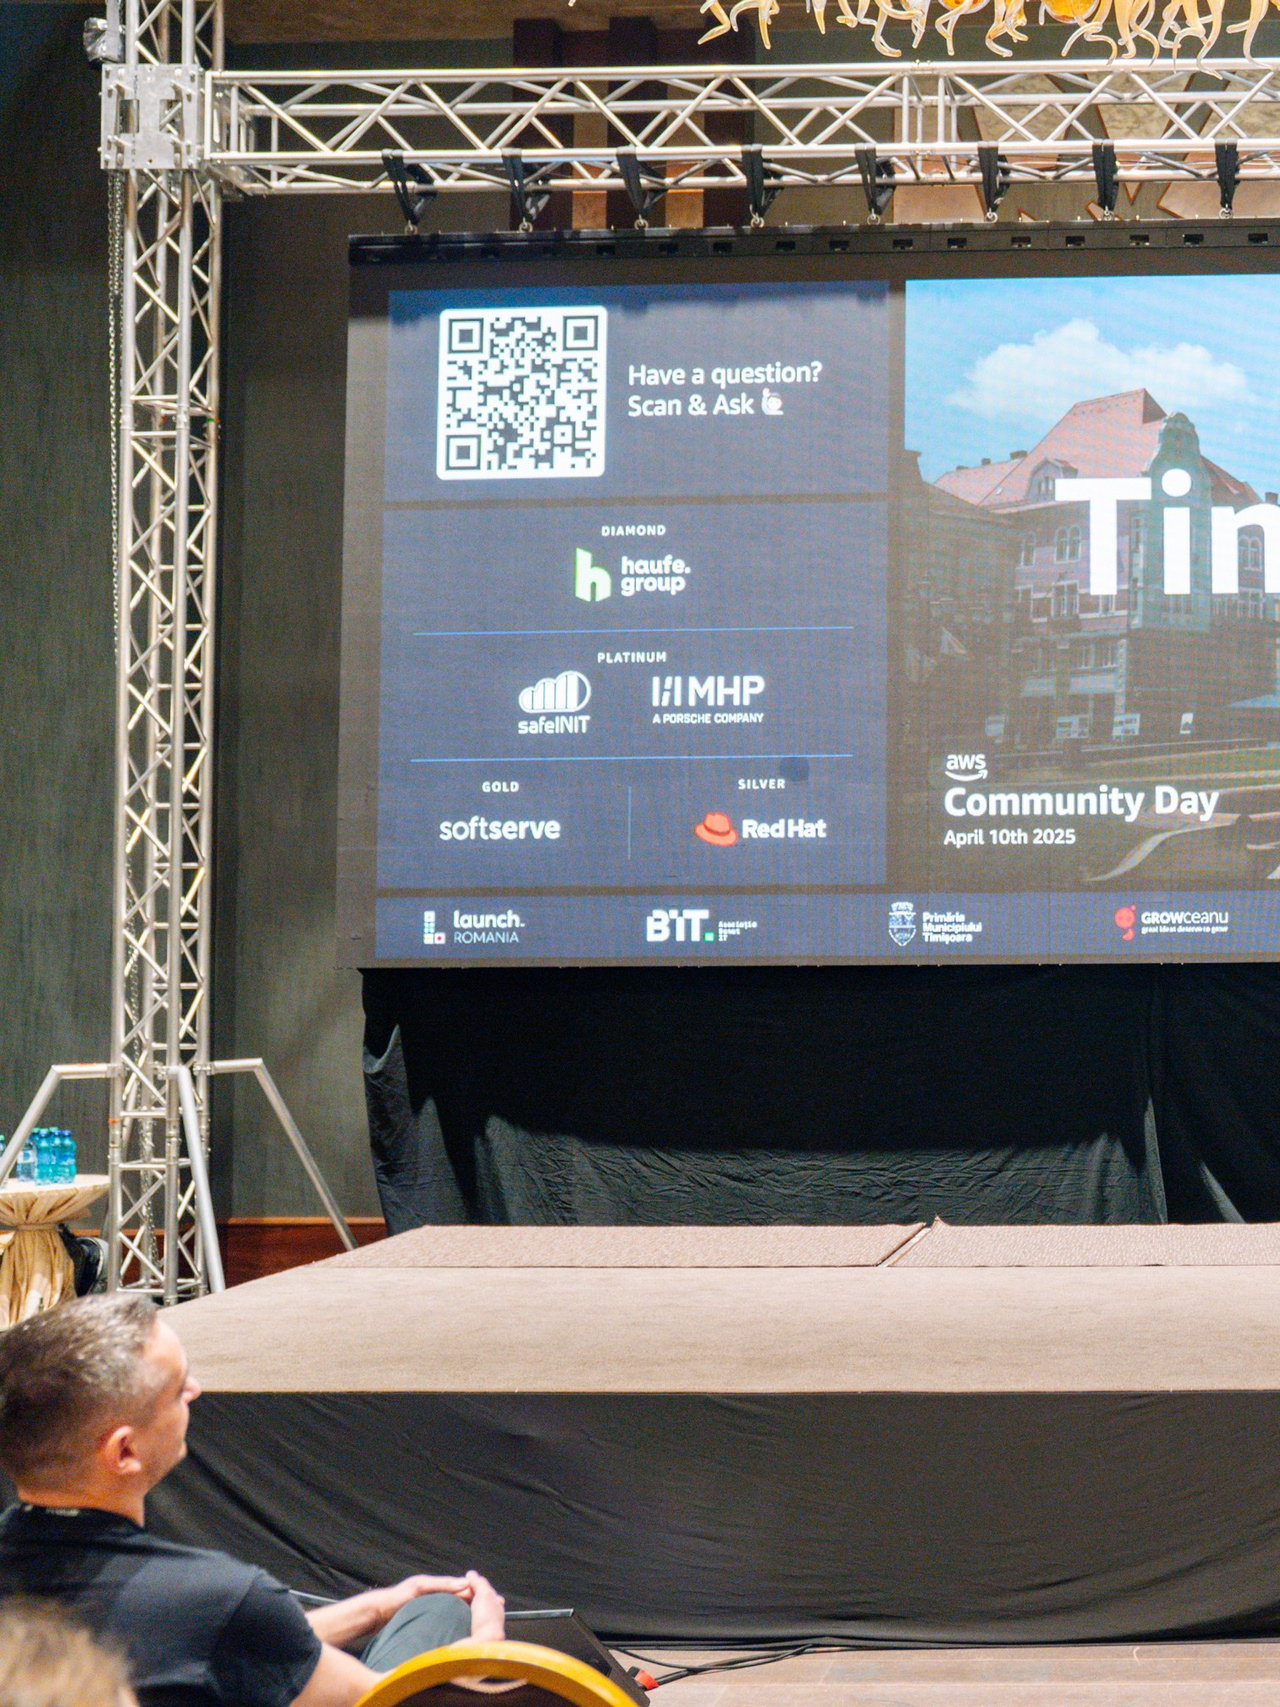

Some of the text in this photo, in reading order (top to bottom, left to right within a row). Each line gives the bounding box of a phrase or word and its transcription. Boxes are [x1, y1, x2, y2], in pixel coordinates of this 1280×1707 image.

[628, 361, 823, 389] Have a question?
[628, 393, 755, 418] Scan & Ask
[601, 524, 667, 537] DIAMOND
[620, 576, 687, 597] group
[597, 651, 667, 664] PLATINUM
[689, 675, 766, 707] MHP
[517, 715, 591, 735] safeINIT
[652, 712, 764, 725] A PORSCHE COMPANY
[945, 753, 988, 773] aws
[481, 780, 520, 793] GOLD
[737, 778, 786, 790] SILVER
[944, 784, 1220, 823] Community Day
[439, 815, 562, 841] softserve
[742, 817, 827, 839] Red Hat
[943, 828, 1076, 848] April 10th 2025
[1141, 911, 1229, 925] GROWceanu
[454, 931, 519, 944] ROMANIA
